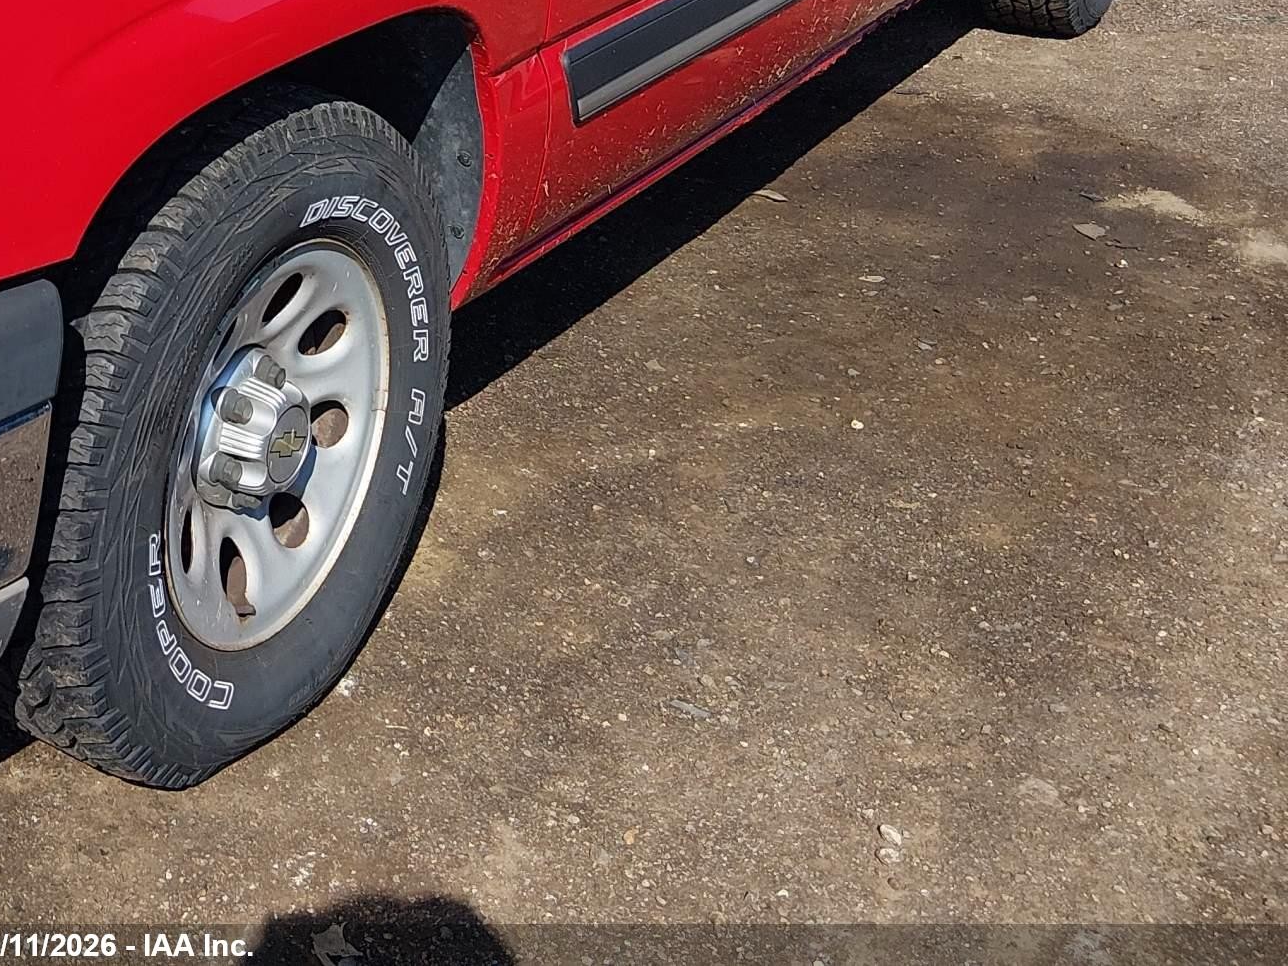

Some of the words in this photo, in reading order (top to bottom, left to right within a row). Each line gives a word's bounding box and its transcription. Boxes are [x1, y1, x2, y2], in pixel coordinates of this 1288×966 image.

[299, 195, 430, 363] DISCOVERER
[395, 388, 426, 496] A/T
[148, 530, 235, 710] COOPER
